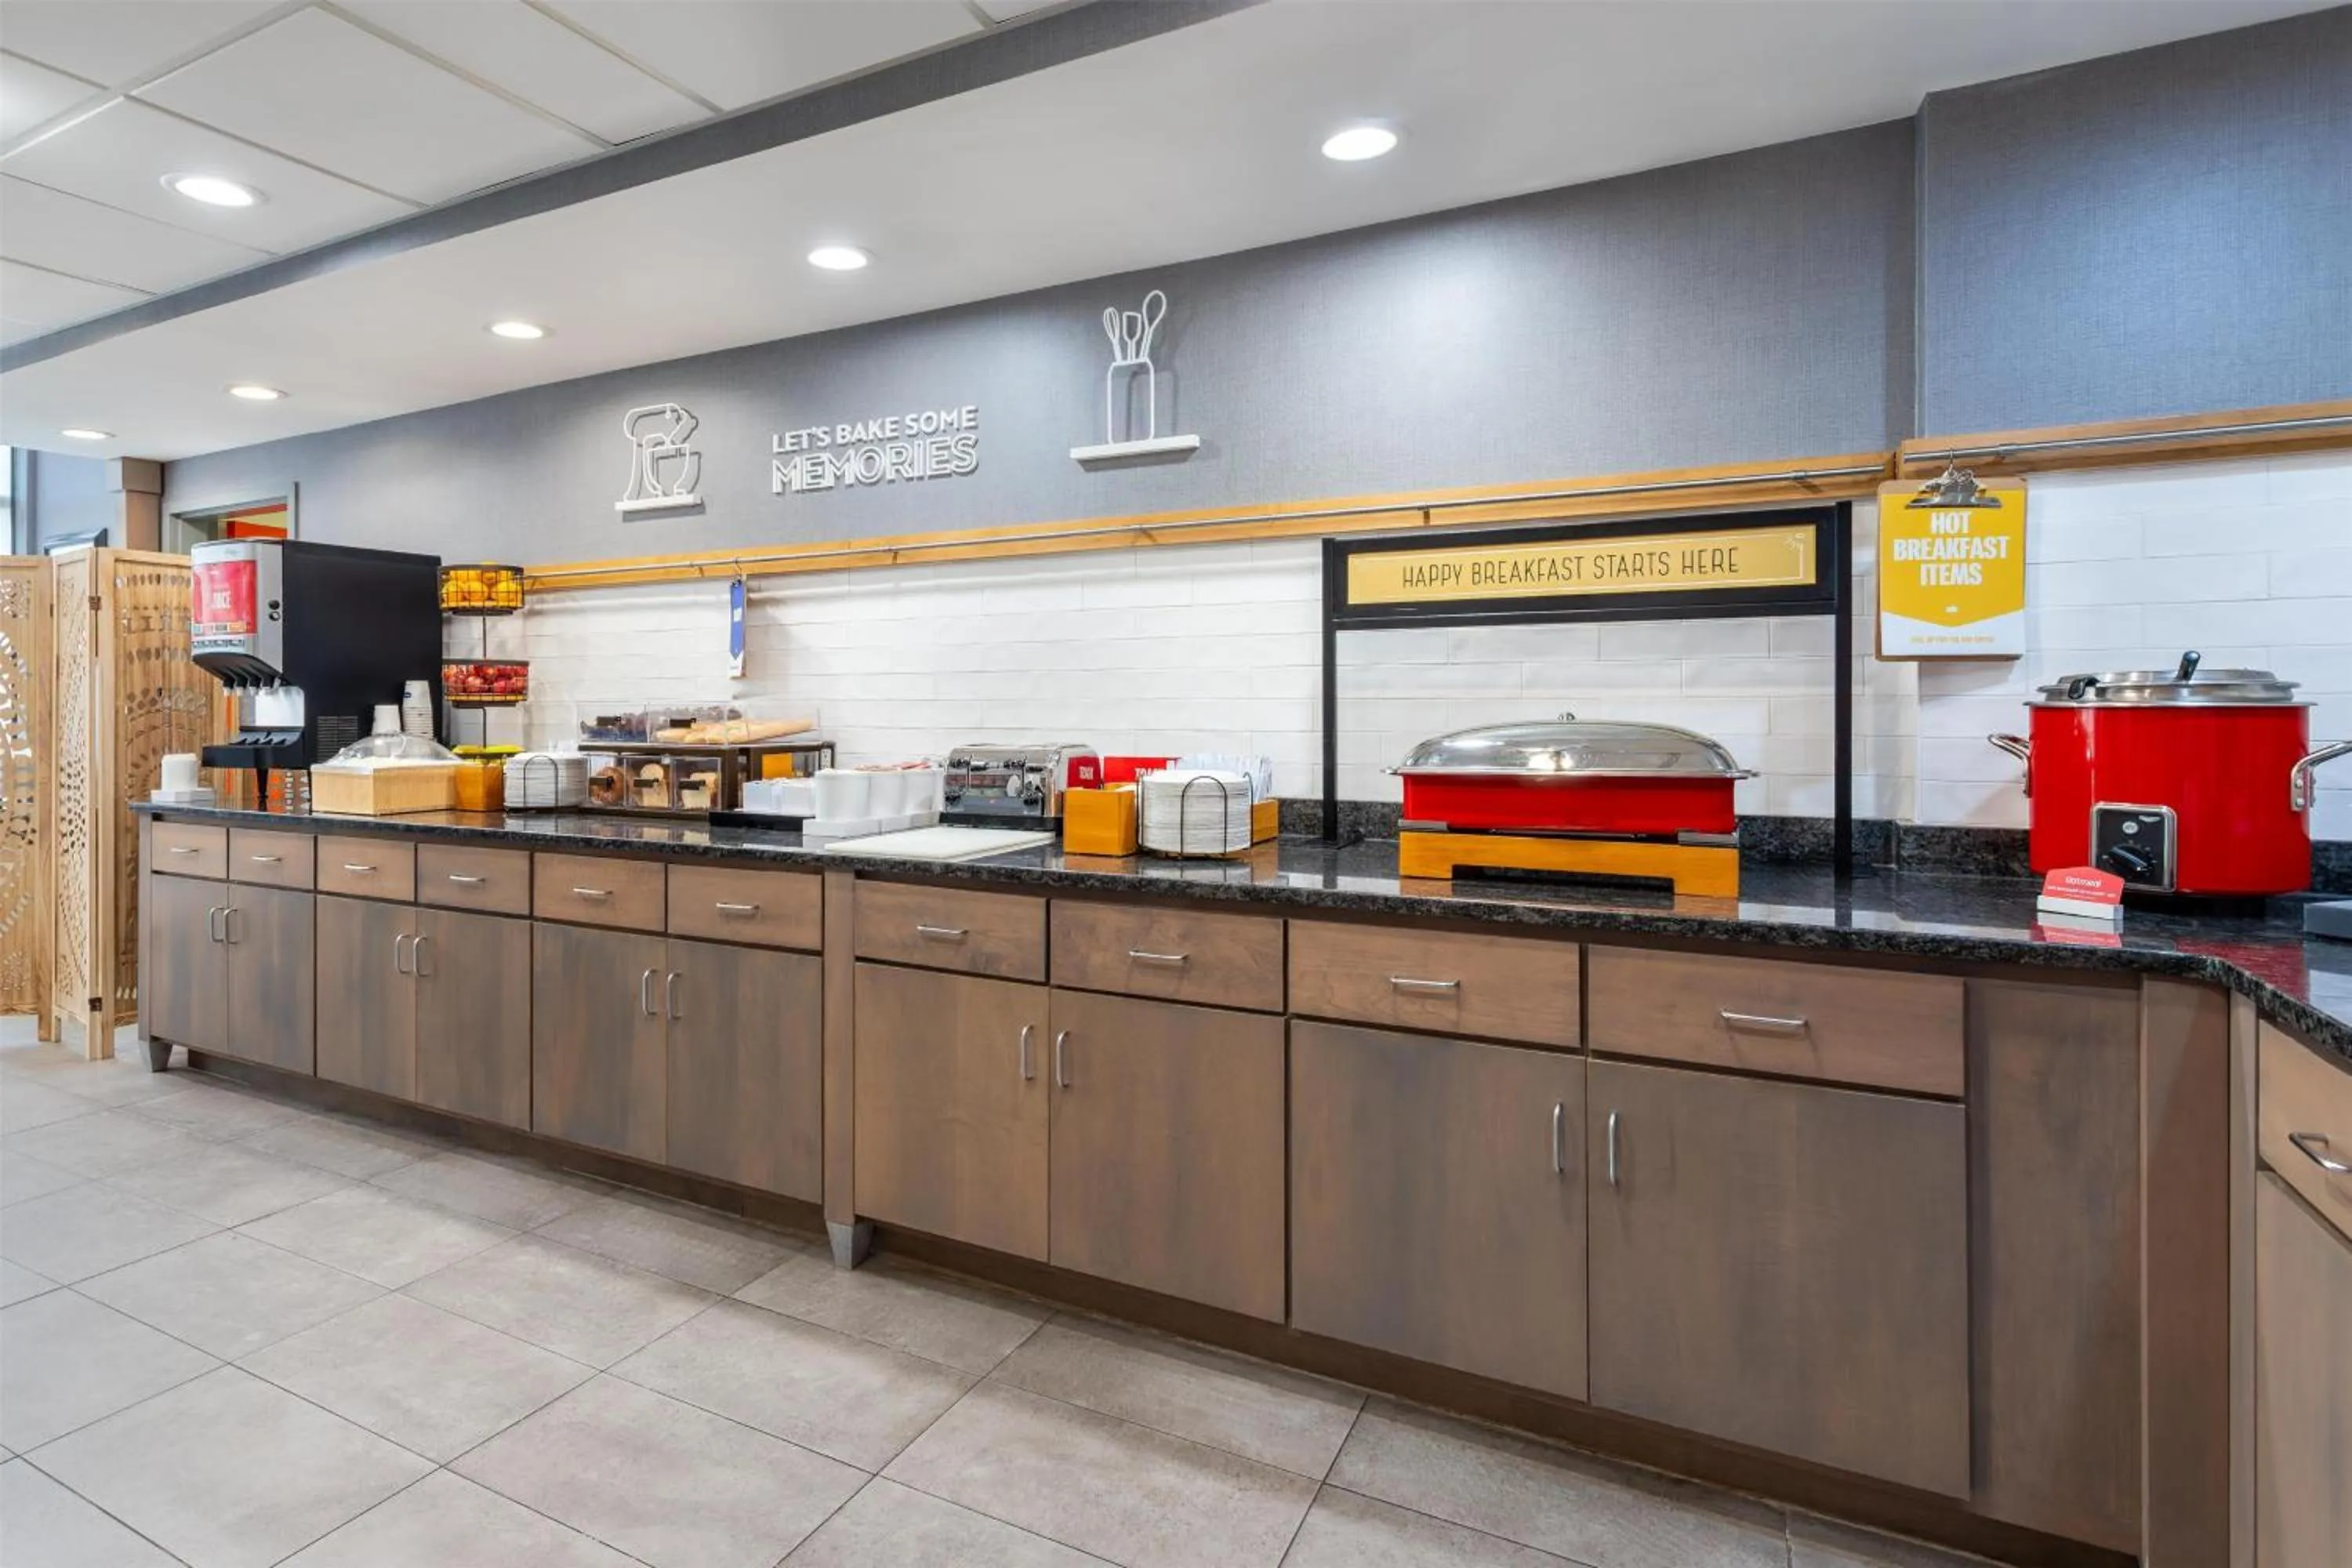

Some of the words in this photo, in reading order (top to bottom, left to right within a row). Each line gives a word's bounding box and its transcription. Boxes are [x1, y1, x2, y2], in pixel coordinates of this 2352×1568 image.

[772, 426, 831, 454] LET'S
[836, 416, 900, 445] BAKE
[905, 405, 978, 437] SOME
[771, 433, 978, 494] MEMORIES
[1931, 512, 1972, 534] HOT
[1893, 536, 2010, 561] BREAKFAST
[1403, 564, 1462, 588] HAPPY
[1472, 555, 1584, 586] BREAKFAST
[1593, 551, 1671, 579] STARTS
[1682, 547, 1739, 575] HERE
[1920, 563, 1983, 586] ITEMS
